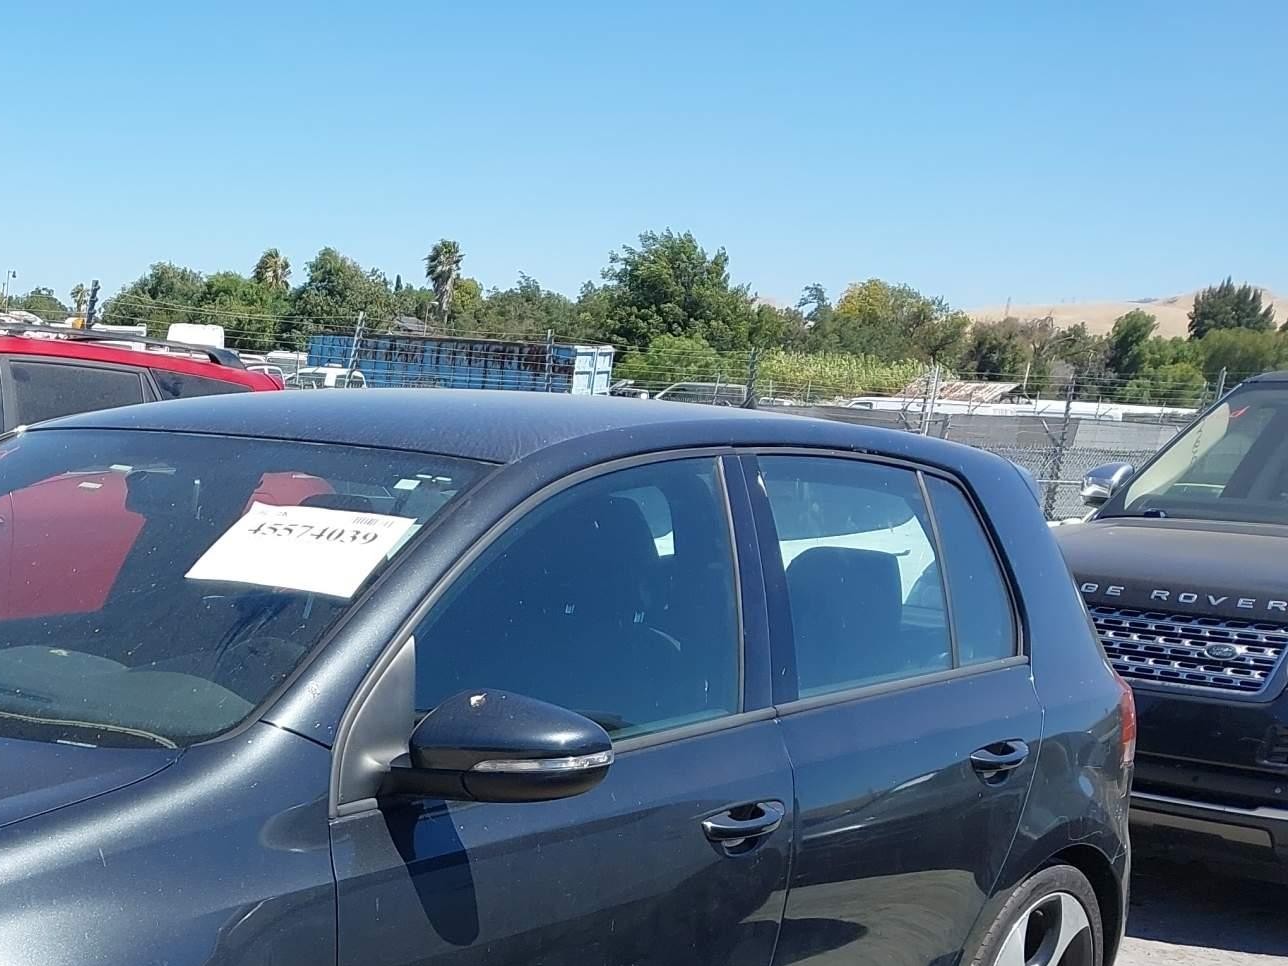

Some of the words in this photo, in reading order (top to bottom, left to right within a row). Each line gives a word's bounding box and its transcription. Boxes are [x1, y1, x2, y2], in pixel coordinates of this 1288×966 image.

[247, 521, 379, 545] 45574039
[1079, 581, 1125, 597] GE
[1150, 588, 1288, 612] ROVER
